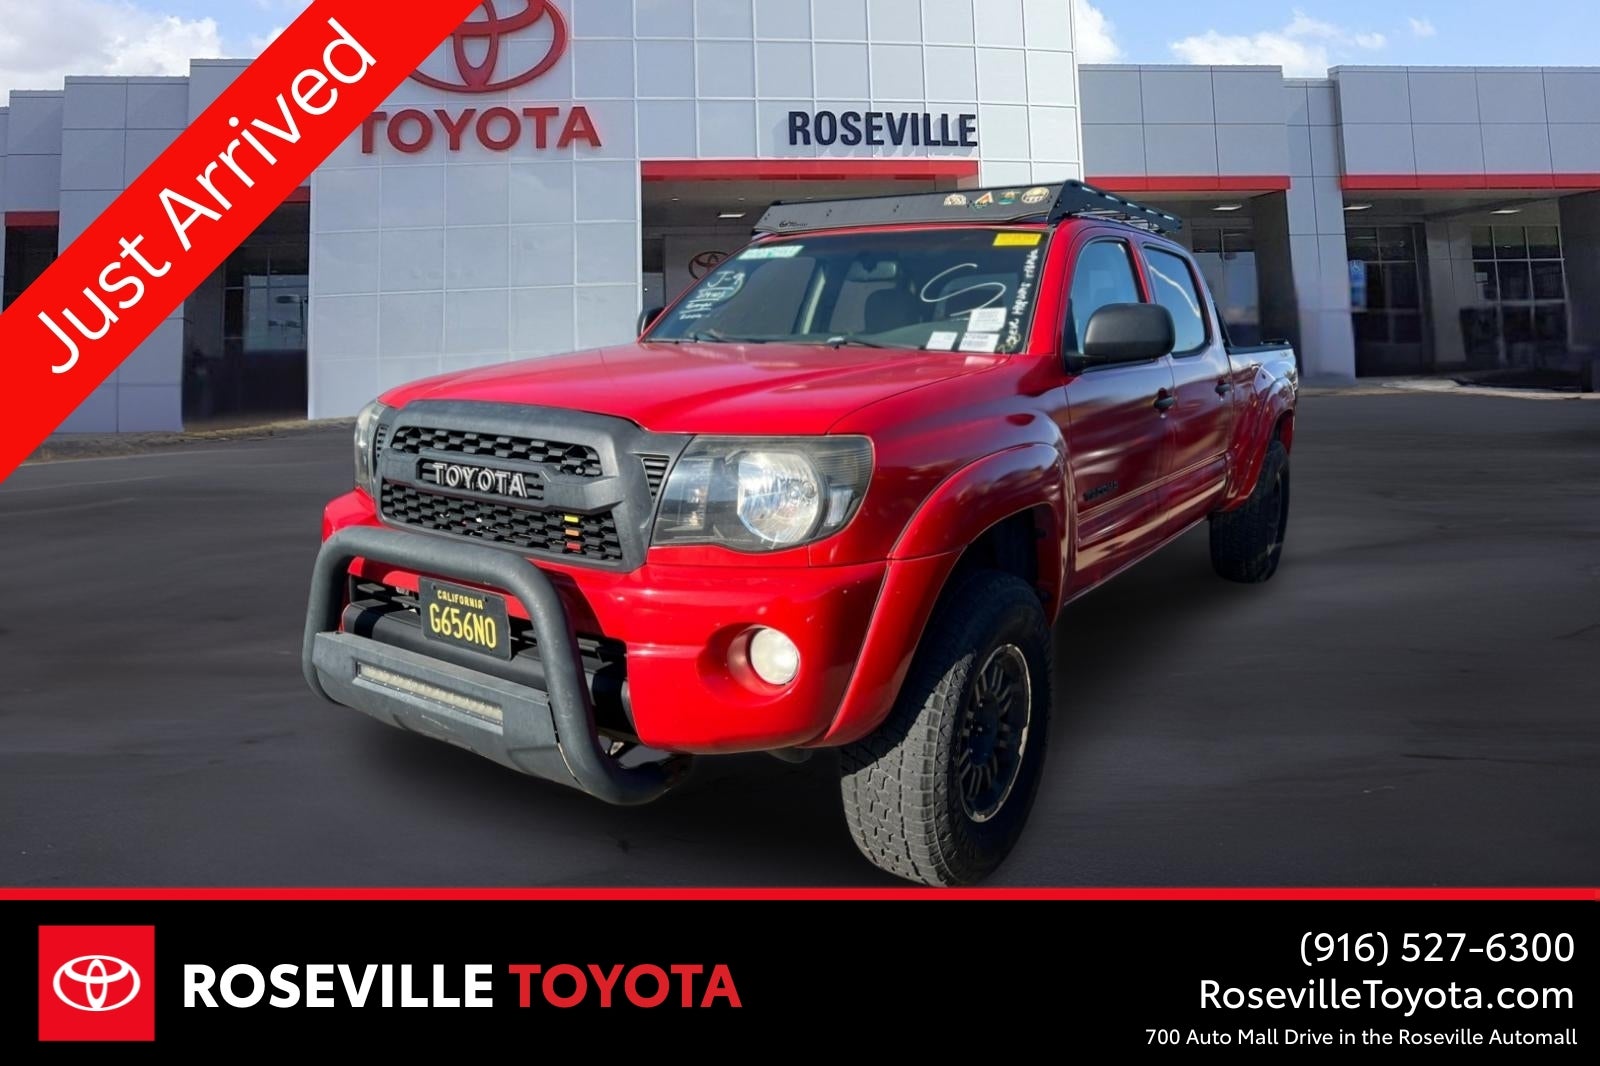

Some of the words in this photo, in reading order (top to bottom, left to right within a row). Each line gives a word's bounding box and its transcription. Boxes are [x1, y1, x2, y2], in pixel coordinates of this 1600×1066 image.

[361, 106, 602, 154] TOYOTA
[788, 110, 979, 148] ROSEVILLE
[432, 462, 528, 499] TOYOTA
[436, 589, 484, 610] CALIFORNIA
